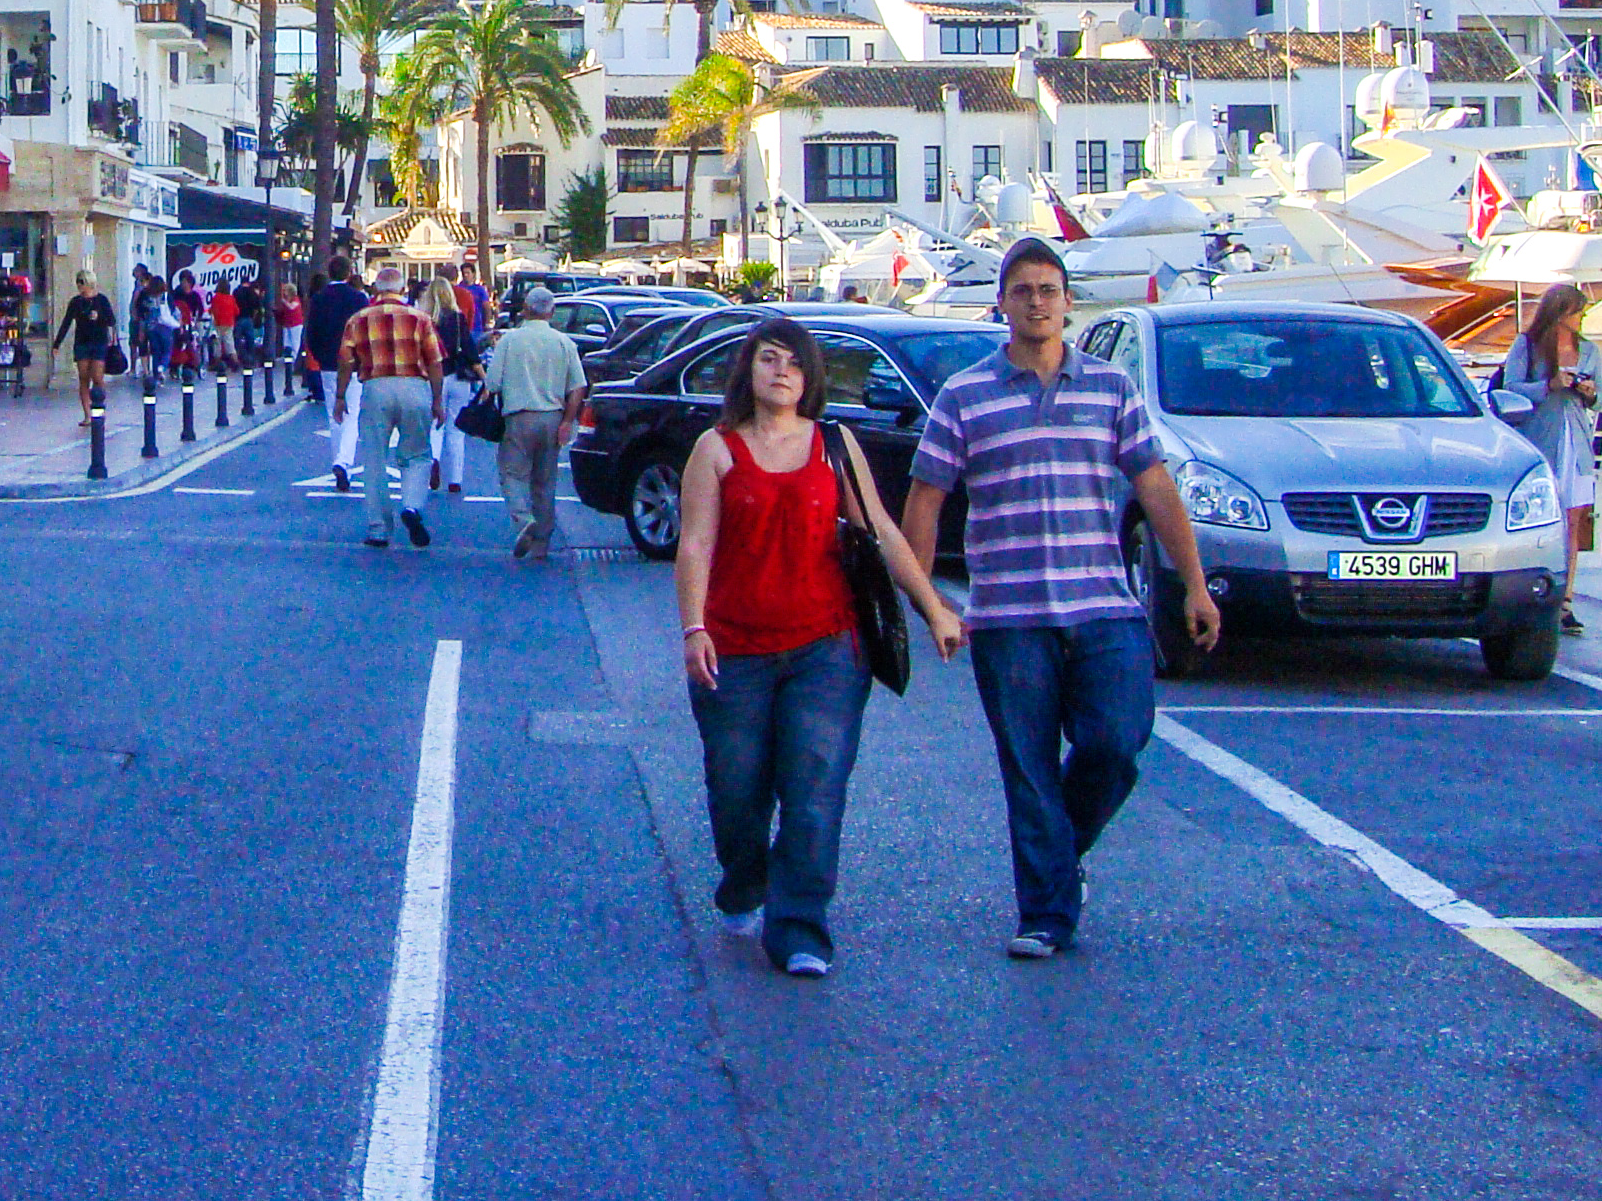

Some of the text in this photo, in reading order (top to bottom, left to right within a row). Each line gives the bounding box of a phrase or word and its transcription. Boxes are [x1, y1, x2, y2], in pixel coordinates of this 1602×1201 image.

[812, 218, 883, 228] alduba Pub
[1348, 556, 1447, 576] 4539 GHM
